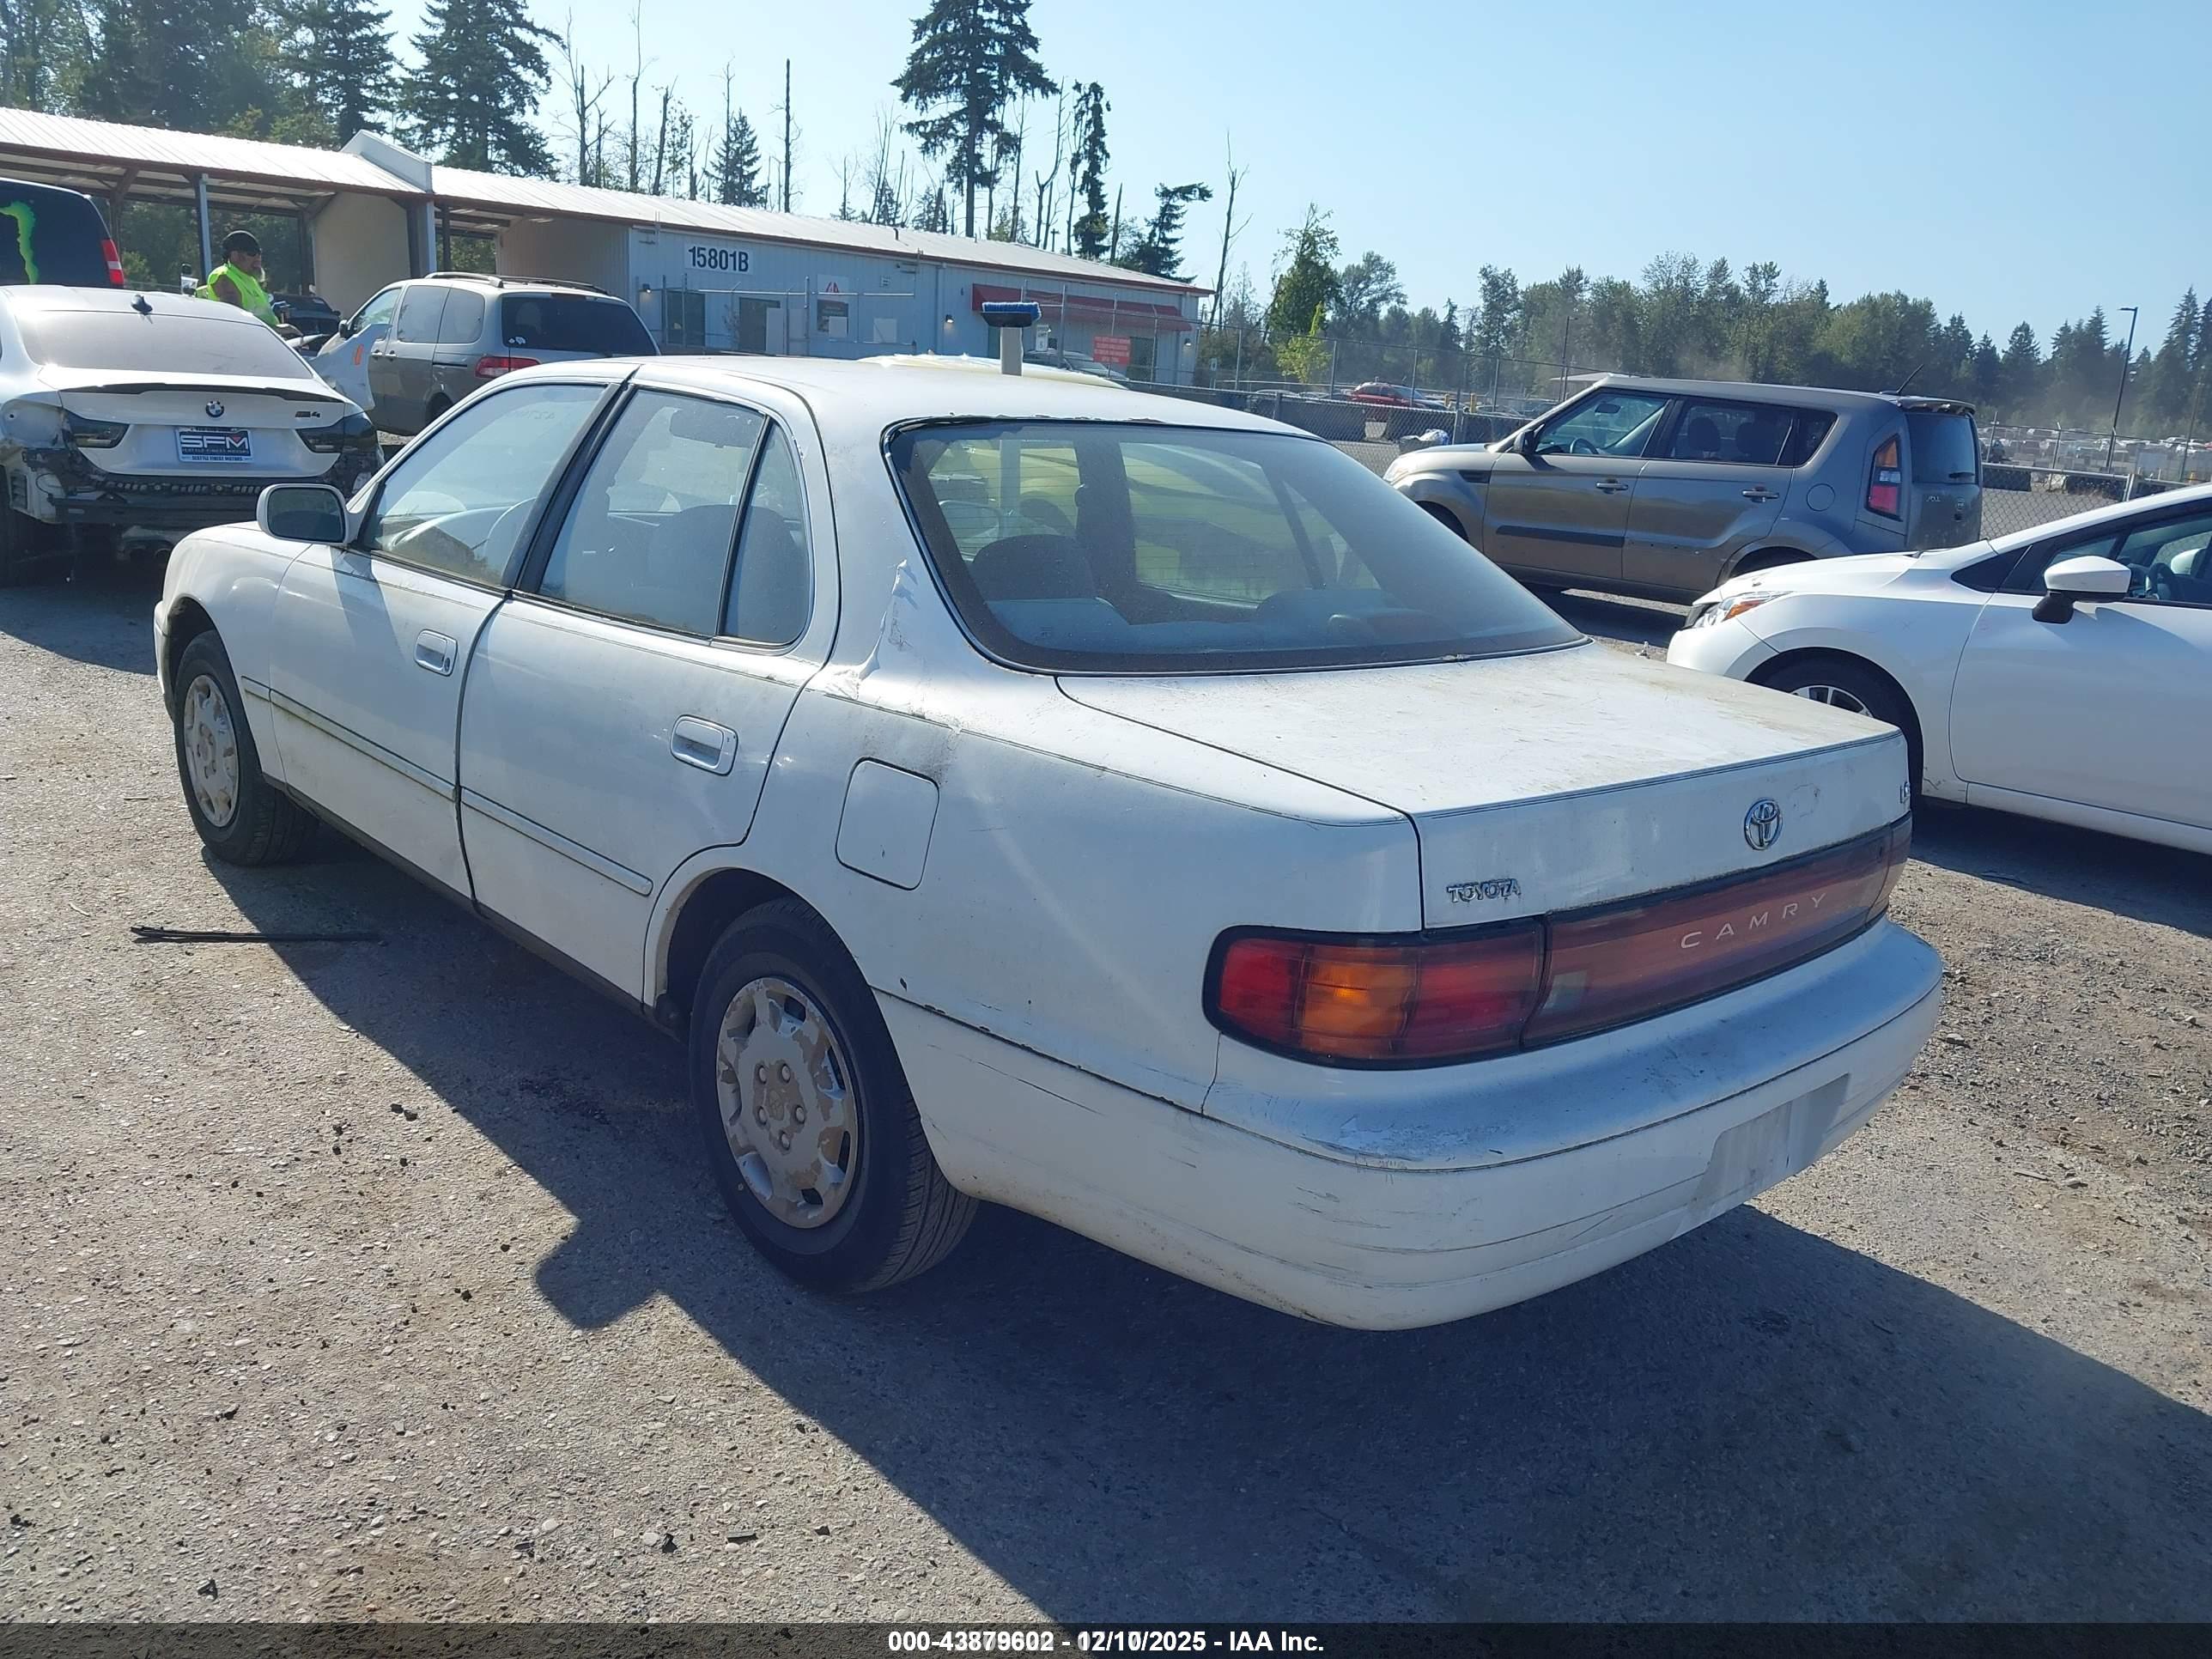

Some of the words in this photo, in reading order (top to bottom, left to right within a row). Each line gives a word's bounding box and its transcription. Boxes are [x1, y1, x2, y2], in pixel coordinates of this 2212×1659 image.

[689, 246, 749, 272] 15801B
[180, 434, 249, 449] SFM
[1446, 878, 1522, 903] TOYOTA
[1680, 892, 1826, 949] CAMRY
